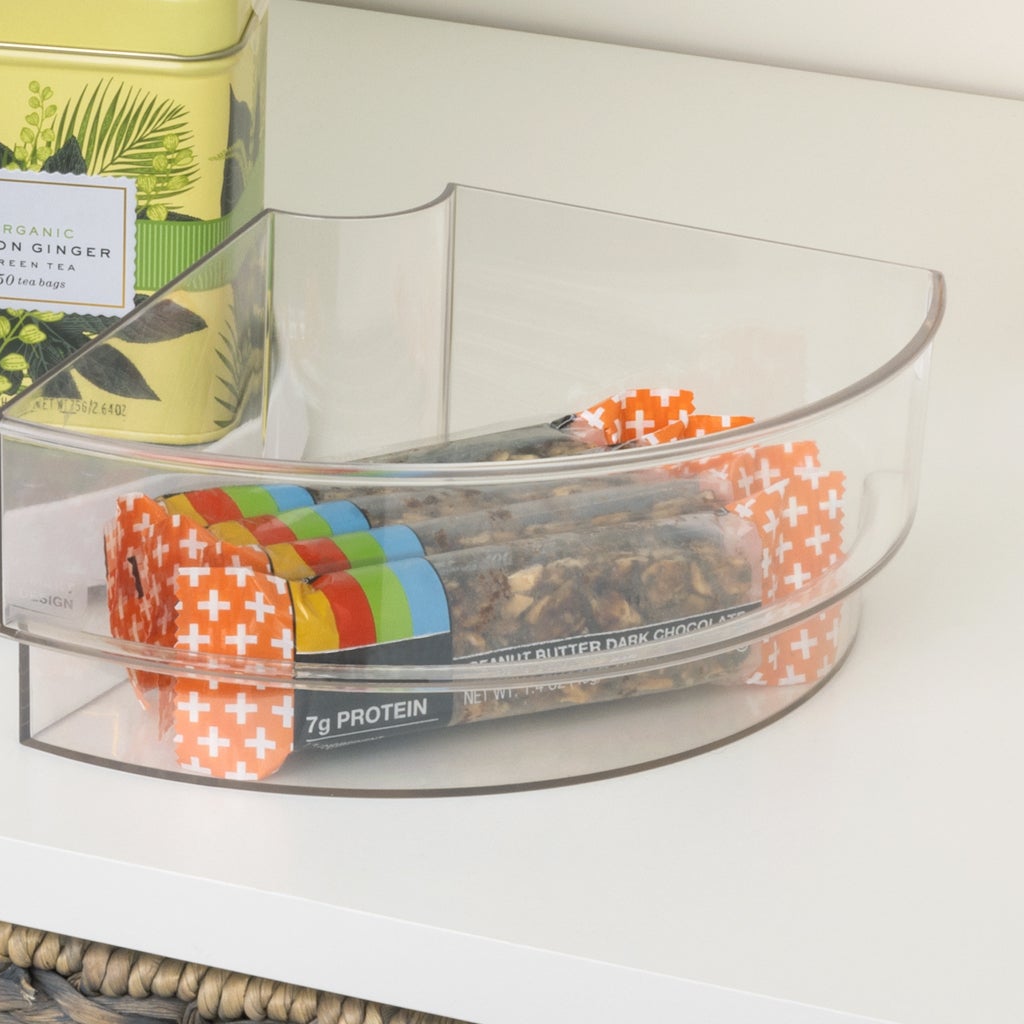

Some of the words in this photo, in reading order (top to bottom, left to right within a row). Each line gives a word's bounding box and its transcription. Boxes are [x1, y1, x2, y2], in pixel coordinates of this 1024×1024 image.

[32, 243, 111, 258] GINGER
[47, 262, 76, 272] TEA
[17, 277, 36, 287] tea
[39, 278, 66, 291] bags
[606, 632, 649, 651] DARK
[463, 690, 488, 705] NET
[306, 716, 330, 736] 7g
[337, 698, 427, 729] PROTEIN
